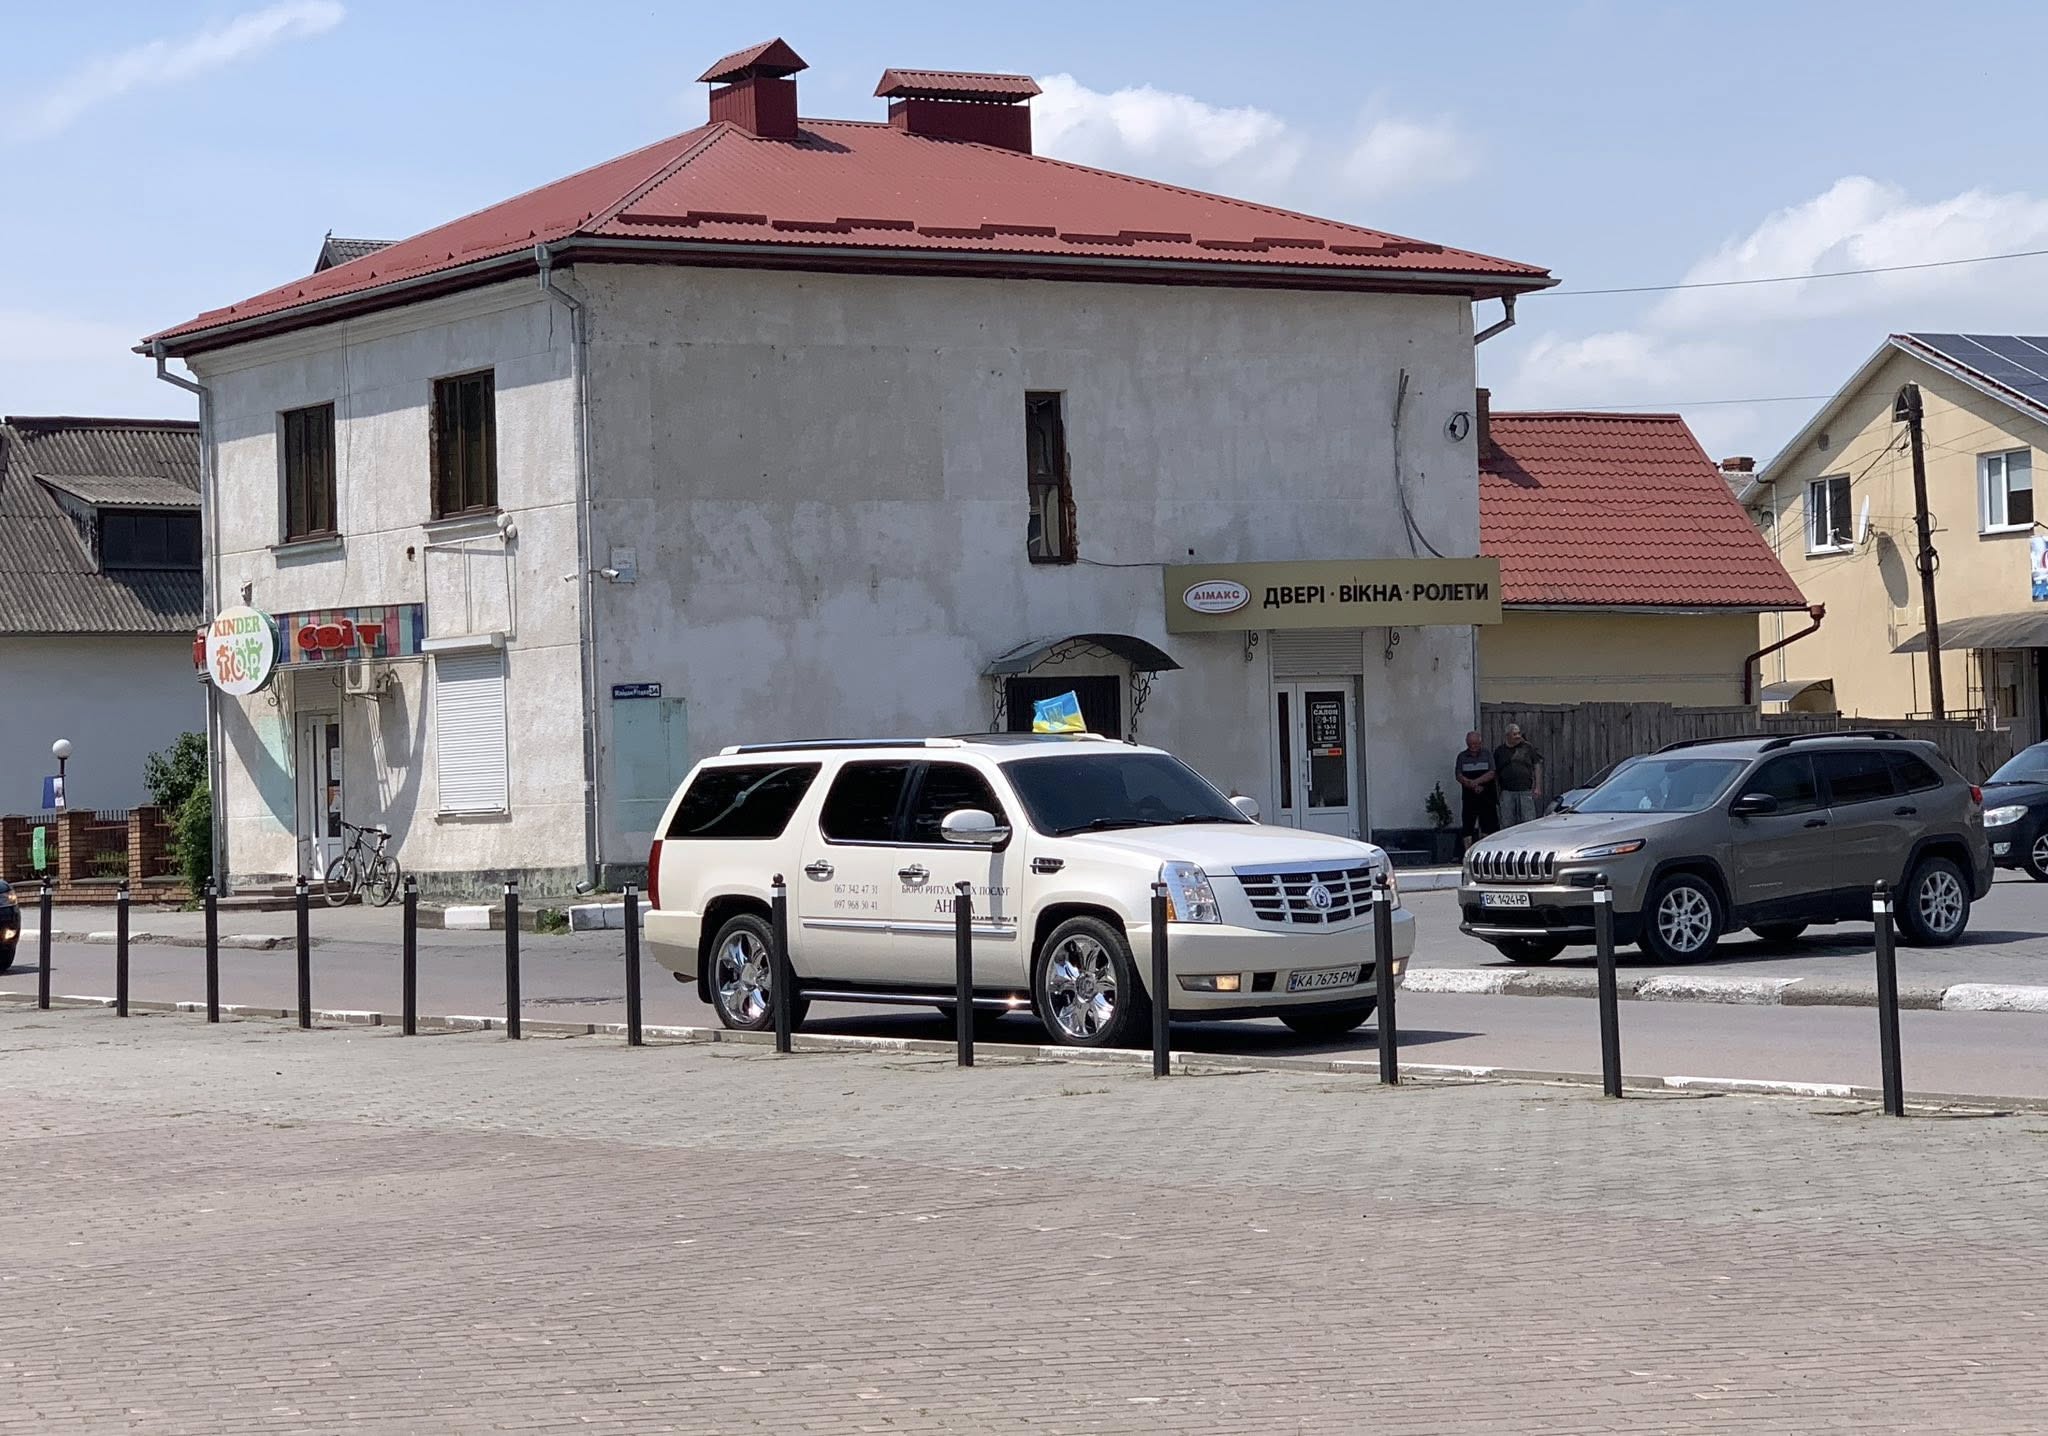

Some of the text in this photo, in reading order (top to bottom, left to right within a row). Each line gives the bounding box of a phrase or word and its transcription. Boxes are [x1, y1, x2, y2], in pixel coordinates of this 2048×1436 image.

[1263, 583, 1489, 609] ДВЕРІ ВІКНА РОЛЕТИ
[214, 615, 261, 637] KINDER
[834, 884, 846, 893] 067
[861, 884, 869, 894] 47
[901, 884, 924, 894] БЮРО
[979, 886, 1011, 896] ПОСЛУГ
[1498, 895, 1515, 905] 1424
[1314, 973, 1339, 986] 7675
